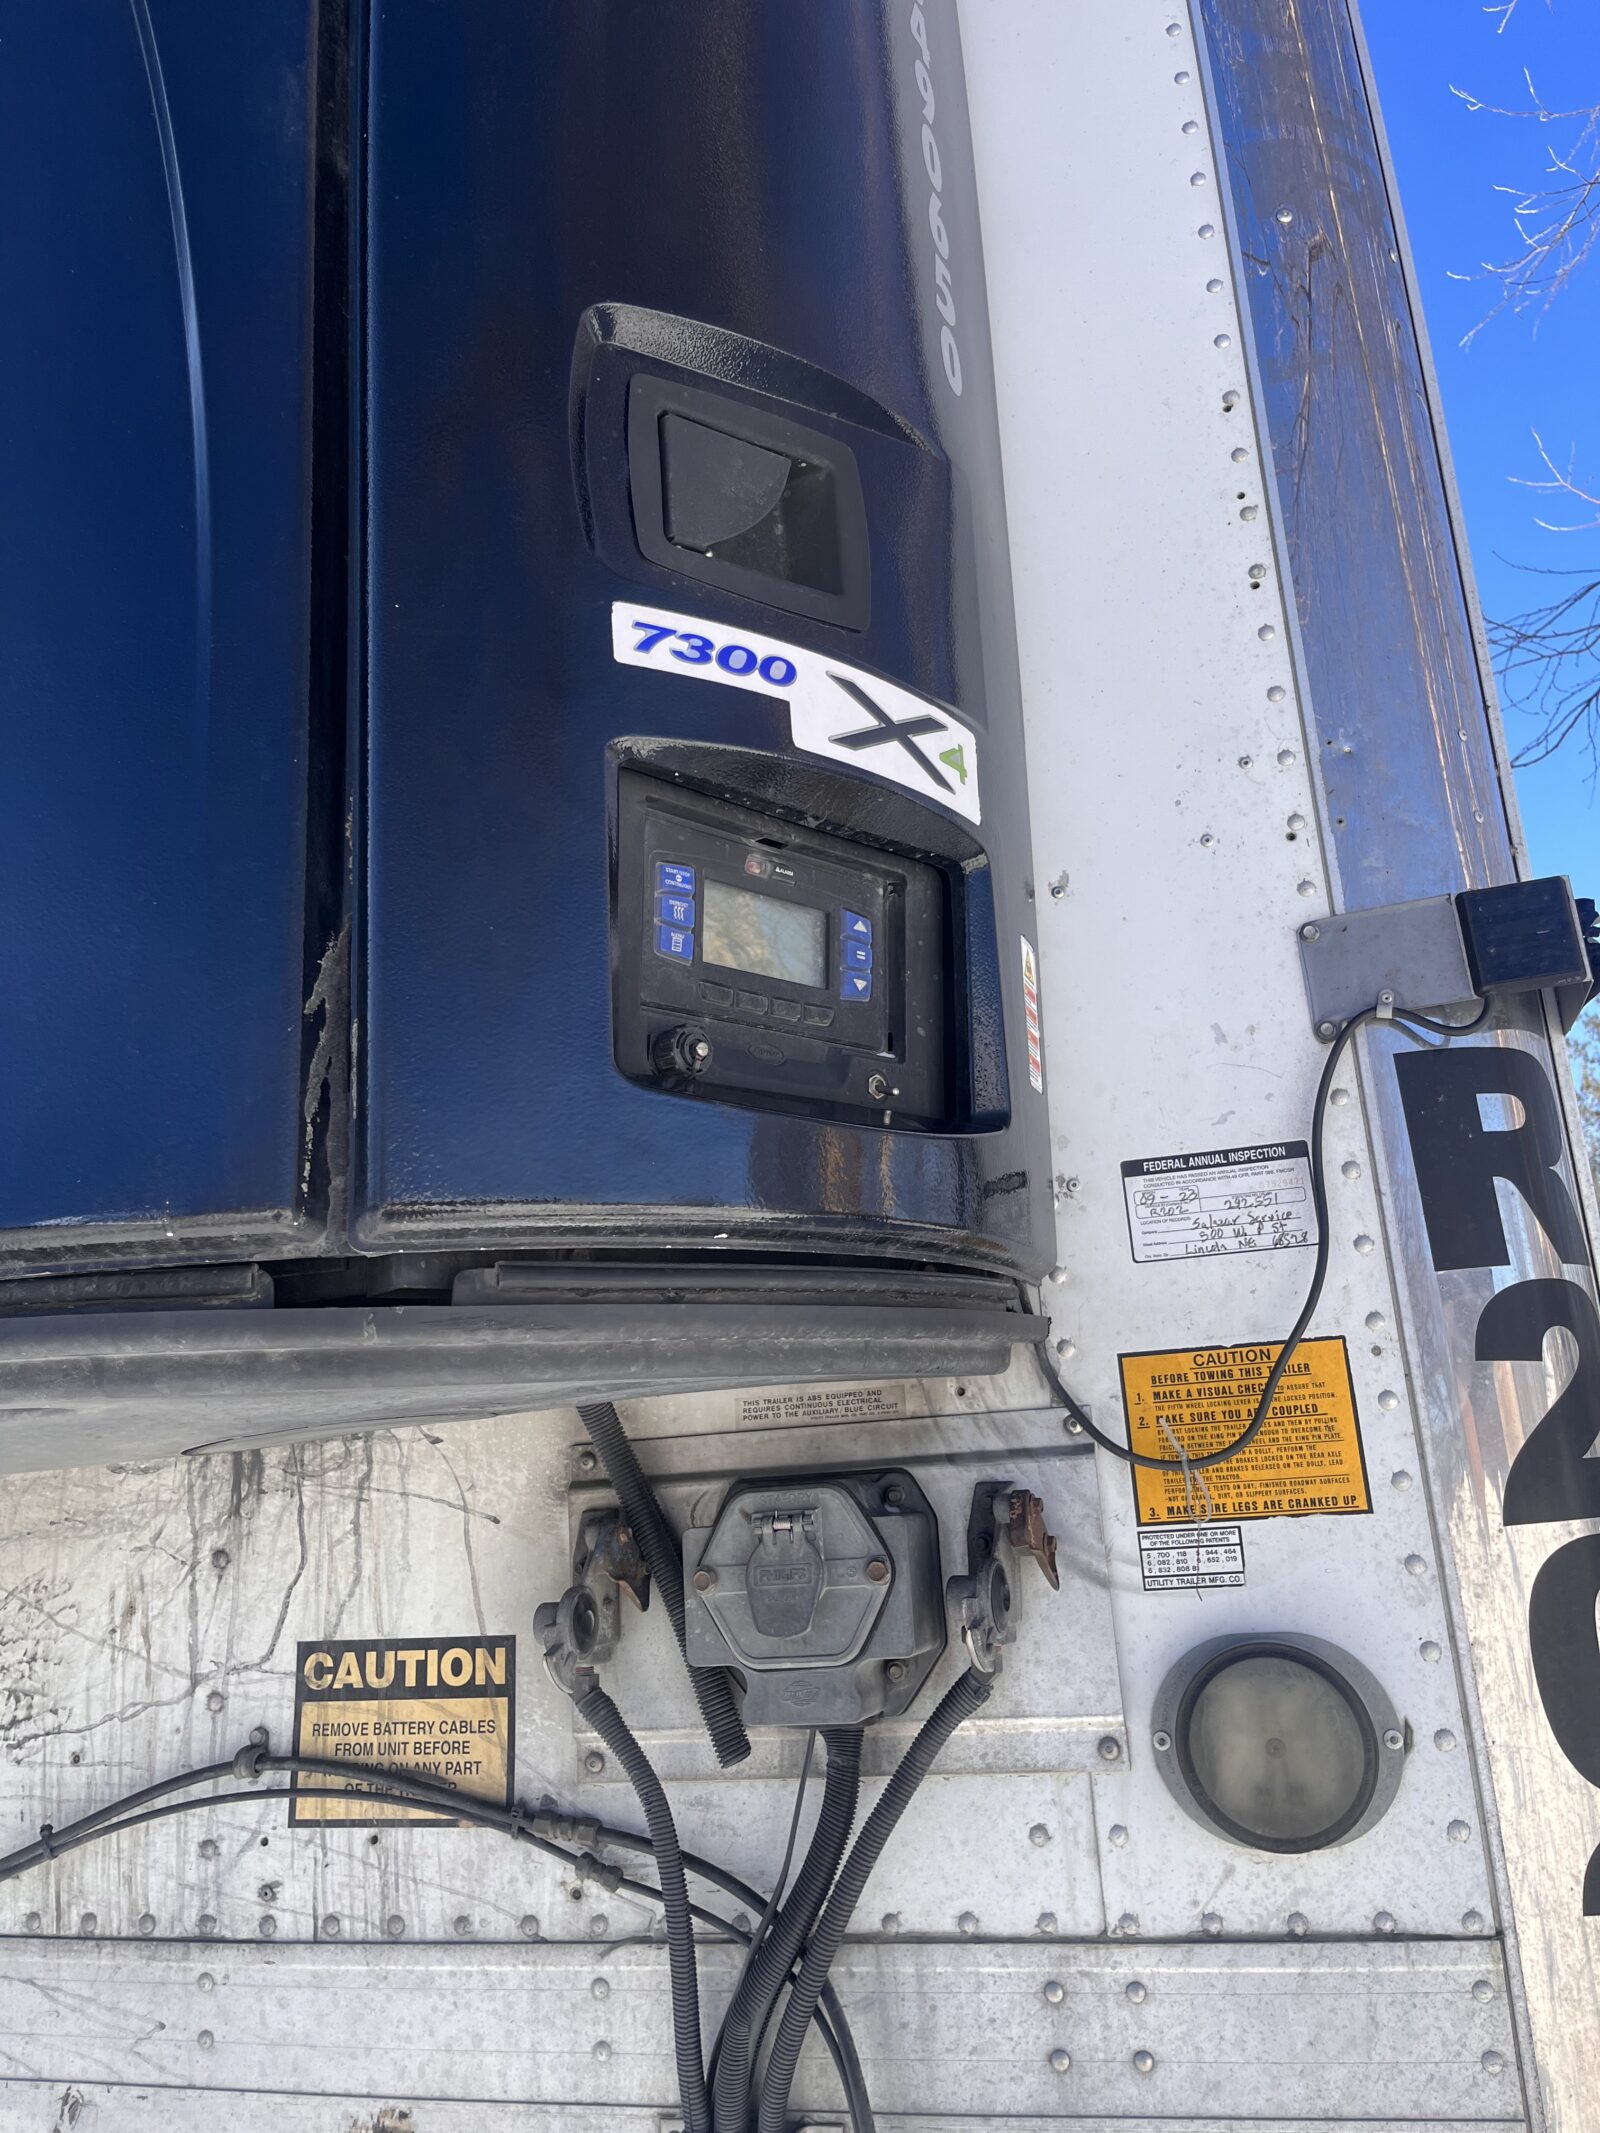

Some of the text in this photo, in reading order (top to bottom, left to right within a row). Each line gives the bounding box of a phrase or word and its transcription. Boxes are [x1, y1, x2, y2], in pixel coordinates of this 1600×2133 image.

[631, 618, 798, 688] 7300
[1143, 1145, 1286, 1173] FEDERAL ANNUAL INSPECTION
[1237, 1164, 1269, 1172] INSPECTION
[1143, 1181, 1175, 1189] CONDUCTED
[1182, 1176, 1216, 1184] ACCORDANCE
[1247, 1206, 1293, 1225] Service
[1192, 1348, 1272, 1367] CAUTION
[1151, 1373, 1189, 1384] BEFORE
[1194, 1369, 1234, 1381] TOWING
[1239, 1367, 1263, 1378] THIS
[763, 1397, 793, 1405] TRAILER
[826, 1391, 863, 1400] EQUIPPED
[1137, 1392, 1144, 1402] 1.
[1153, 1389, 1182, 1401] MAKE
[1186, 1388, 1193, 1398] A
[1196, 1385, 1234, 1397] VISUAL
[1237, 1382, 1268, 1394] CHEC
[1286, 1383, 1309, 1391] ASSURE
[743, 1397, 882, 1414] REQUIRES CONTINUOUS ELECTRICAL
[1207, 1400, 1231, 1408] LOCKING
[1233, 1398, 1252, 1406] LEVER
[1283, 1394, 1306, 1402] LOCKED
[743, 1413, 769, 1421] POWER
[867, 1402, 899, 1411] CIRCUIT
[1138, 1416, 1149, 1426] 2.
[1189, 1411, 1217, 1422] SURE
[1221, 1409, 1242, 1420] YOU
[1271, 1403, 1318, 1416] COUPLED
[1276, 1445, 1303, 1453] PERFORM
[1235, 1456, 1258, 1464] BRAKES
[1213, 1484, 1230, 1492] TESTS
[1259, 1481, 1287, 1489] FINISHED
[1289, 1479, 1317, 1487] ROADWAY
[1319, 1476, 1350, 1485] SURFACES
[1246, 1490, 1272, 1498] SLIPPERY
[1149, 1507, 1159, 1517] 3.
[1232, 1501, 1259, 1512] LEGS
[1263, 1499, 1284, 1510] ARE
[1287, 1496, 1339, 1509] CRANKED
[1343, 1495, 1358, 1505] UP
[1147, 1579, 1174, 1587] UTILITY
[1176, 1577, 1206, 1585] TRAILER
[1208, 1576, 1227, 1584] MFG.
[304, 1646, 506, 1691] CAUTION
[312, 1719, 496, 1737] REMOVE BATTERY CABLES
[334, 1740, 471, 1757] FROM UNIT BEFORE
[445, 1761, 482, 1775] PART
